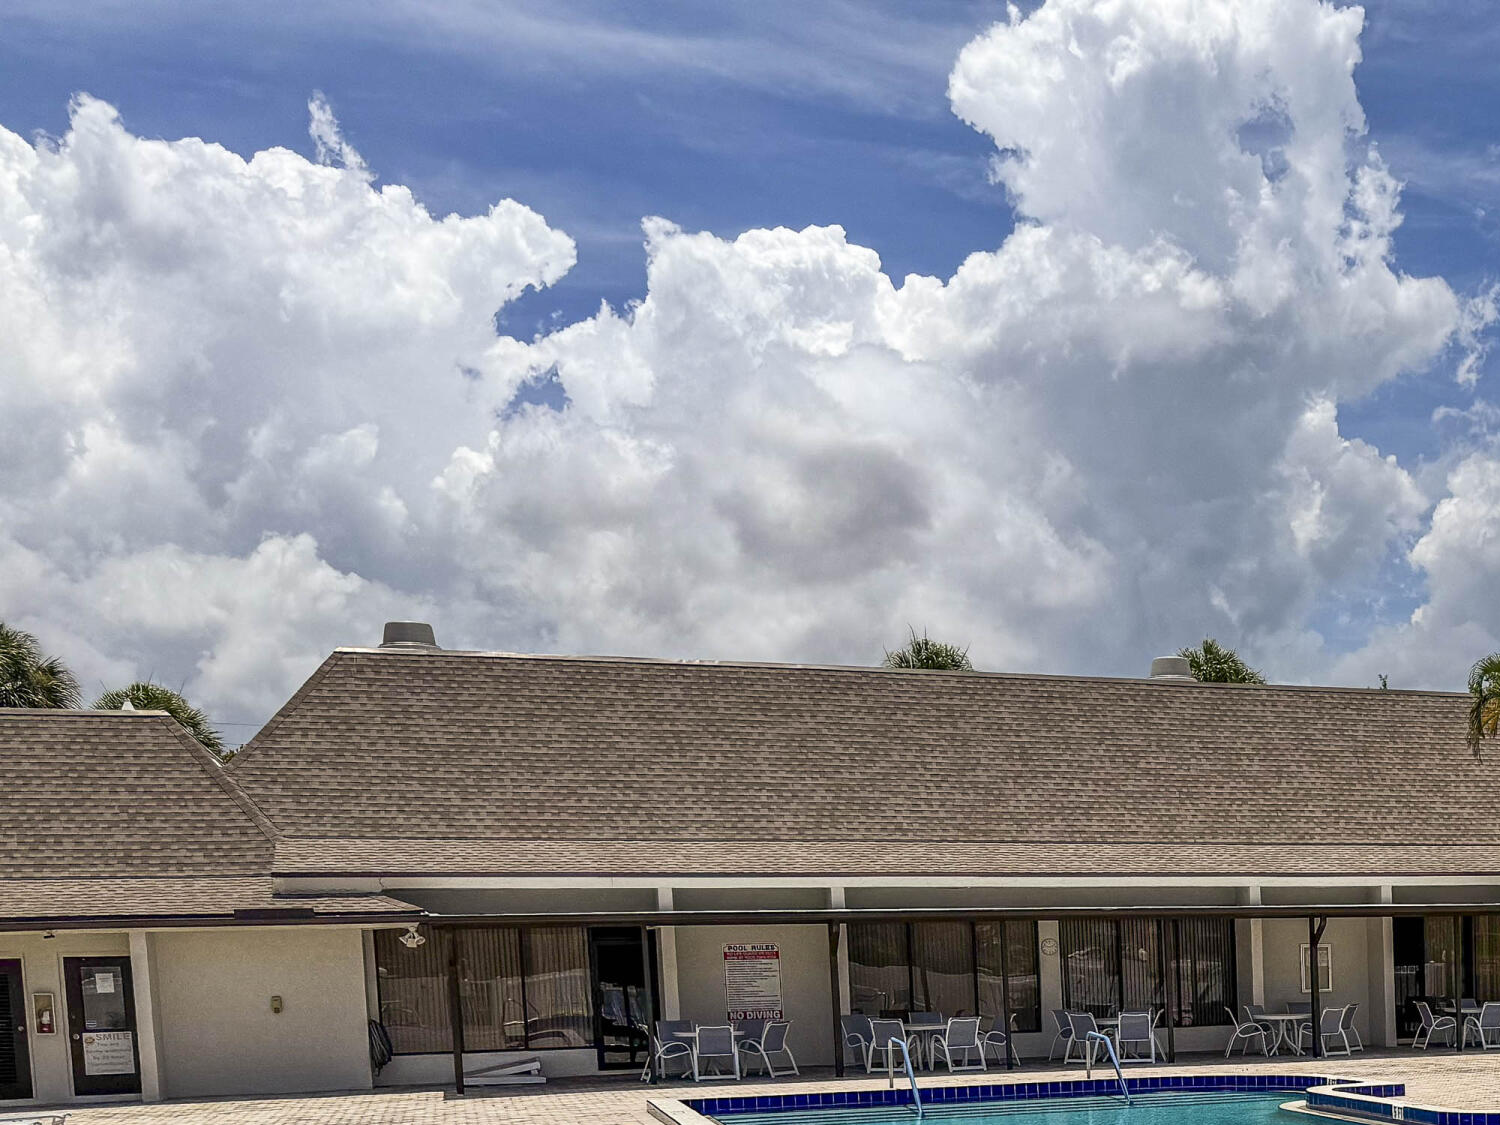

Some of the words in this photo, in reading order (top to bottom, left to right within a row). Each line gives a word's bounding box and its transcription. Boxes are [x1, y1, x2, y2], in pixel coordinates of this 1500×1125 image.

[730, 1011, 744, 1020] NO
[746, 1010, 780, 1020] DIVING
[95, 1032, 131, 1041] SMILE
